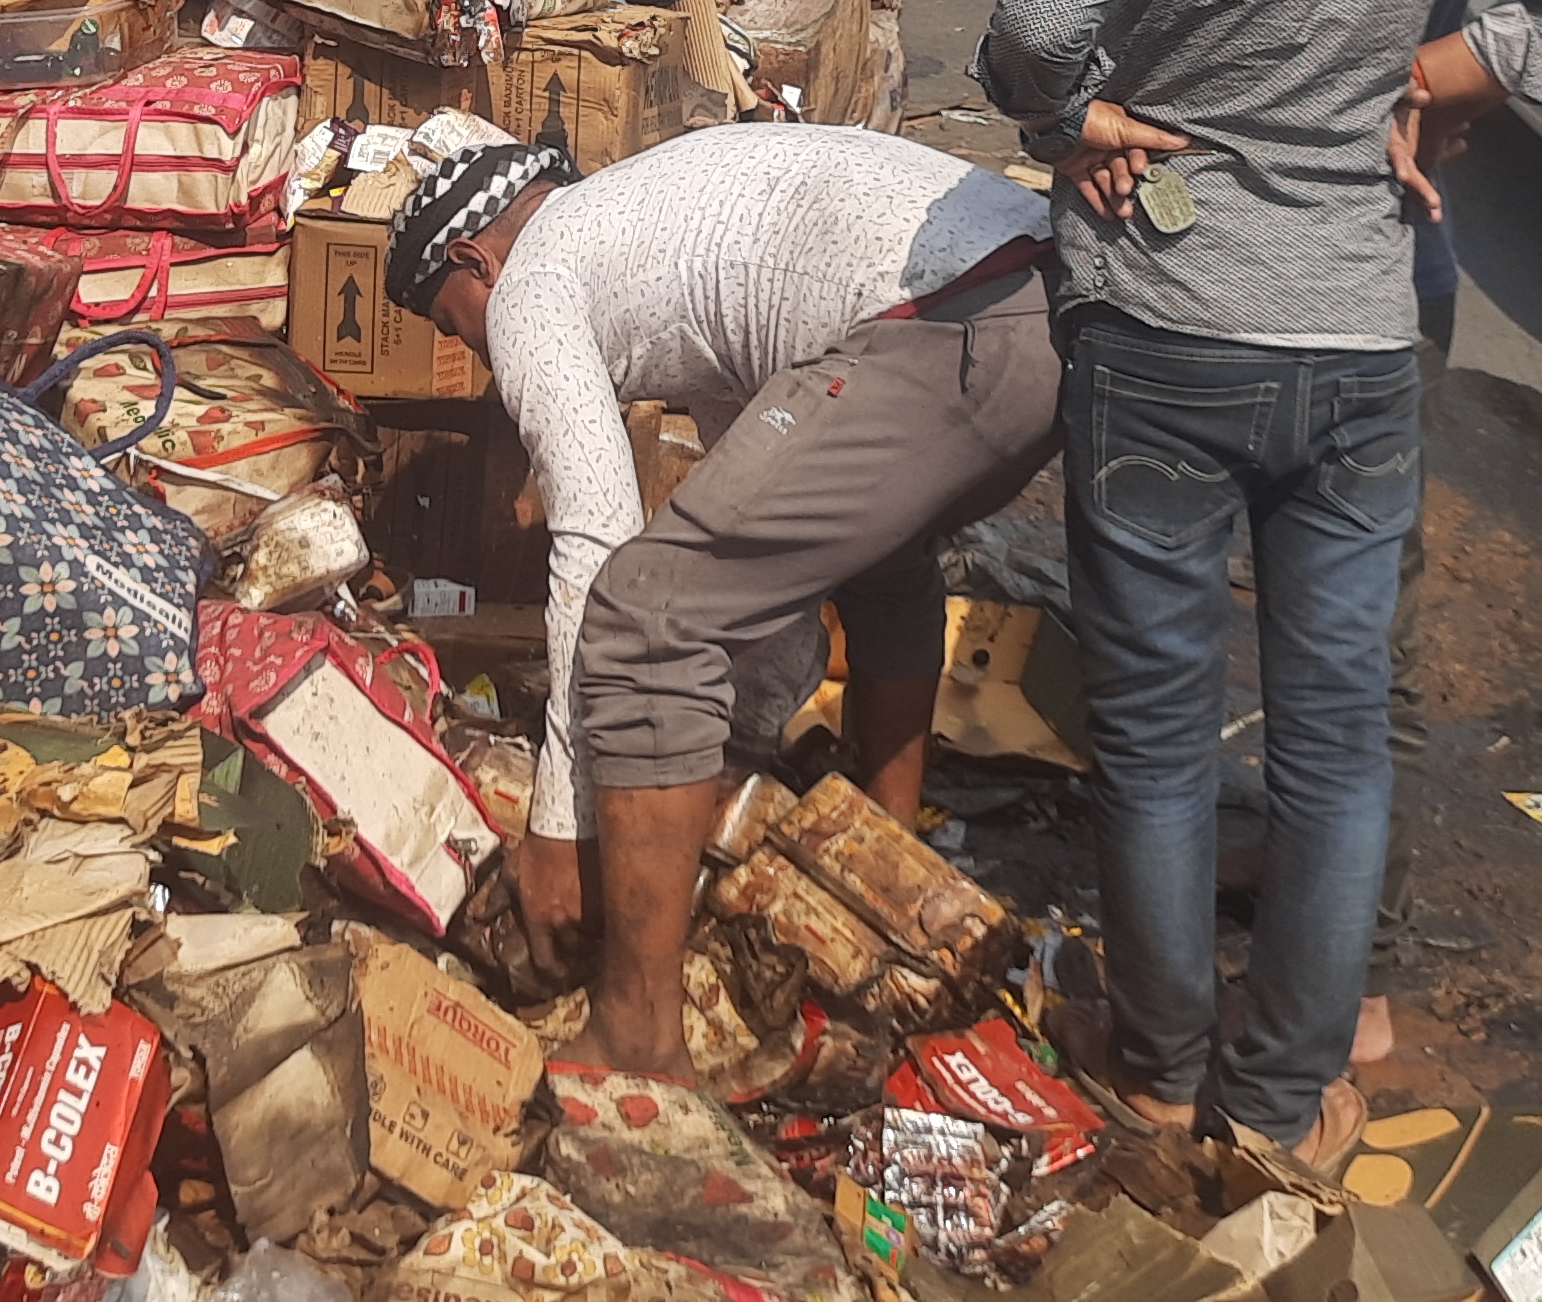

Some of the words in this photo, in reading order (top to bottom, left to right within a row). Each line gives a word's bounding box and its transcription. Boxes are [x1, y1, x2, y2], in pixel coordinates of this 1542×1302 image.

[380, 321, 390, 357] STACK
[428, 991, 516, 1070] TORQUE
[25, 1031, 108, 1209] B-COLEX
[942, 1050, 1035, 1125] B-COLEX
[397, 1120, 431, 1156] WITH
[432, 1150, 469, 1184] CARE
